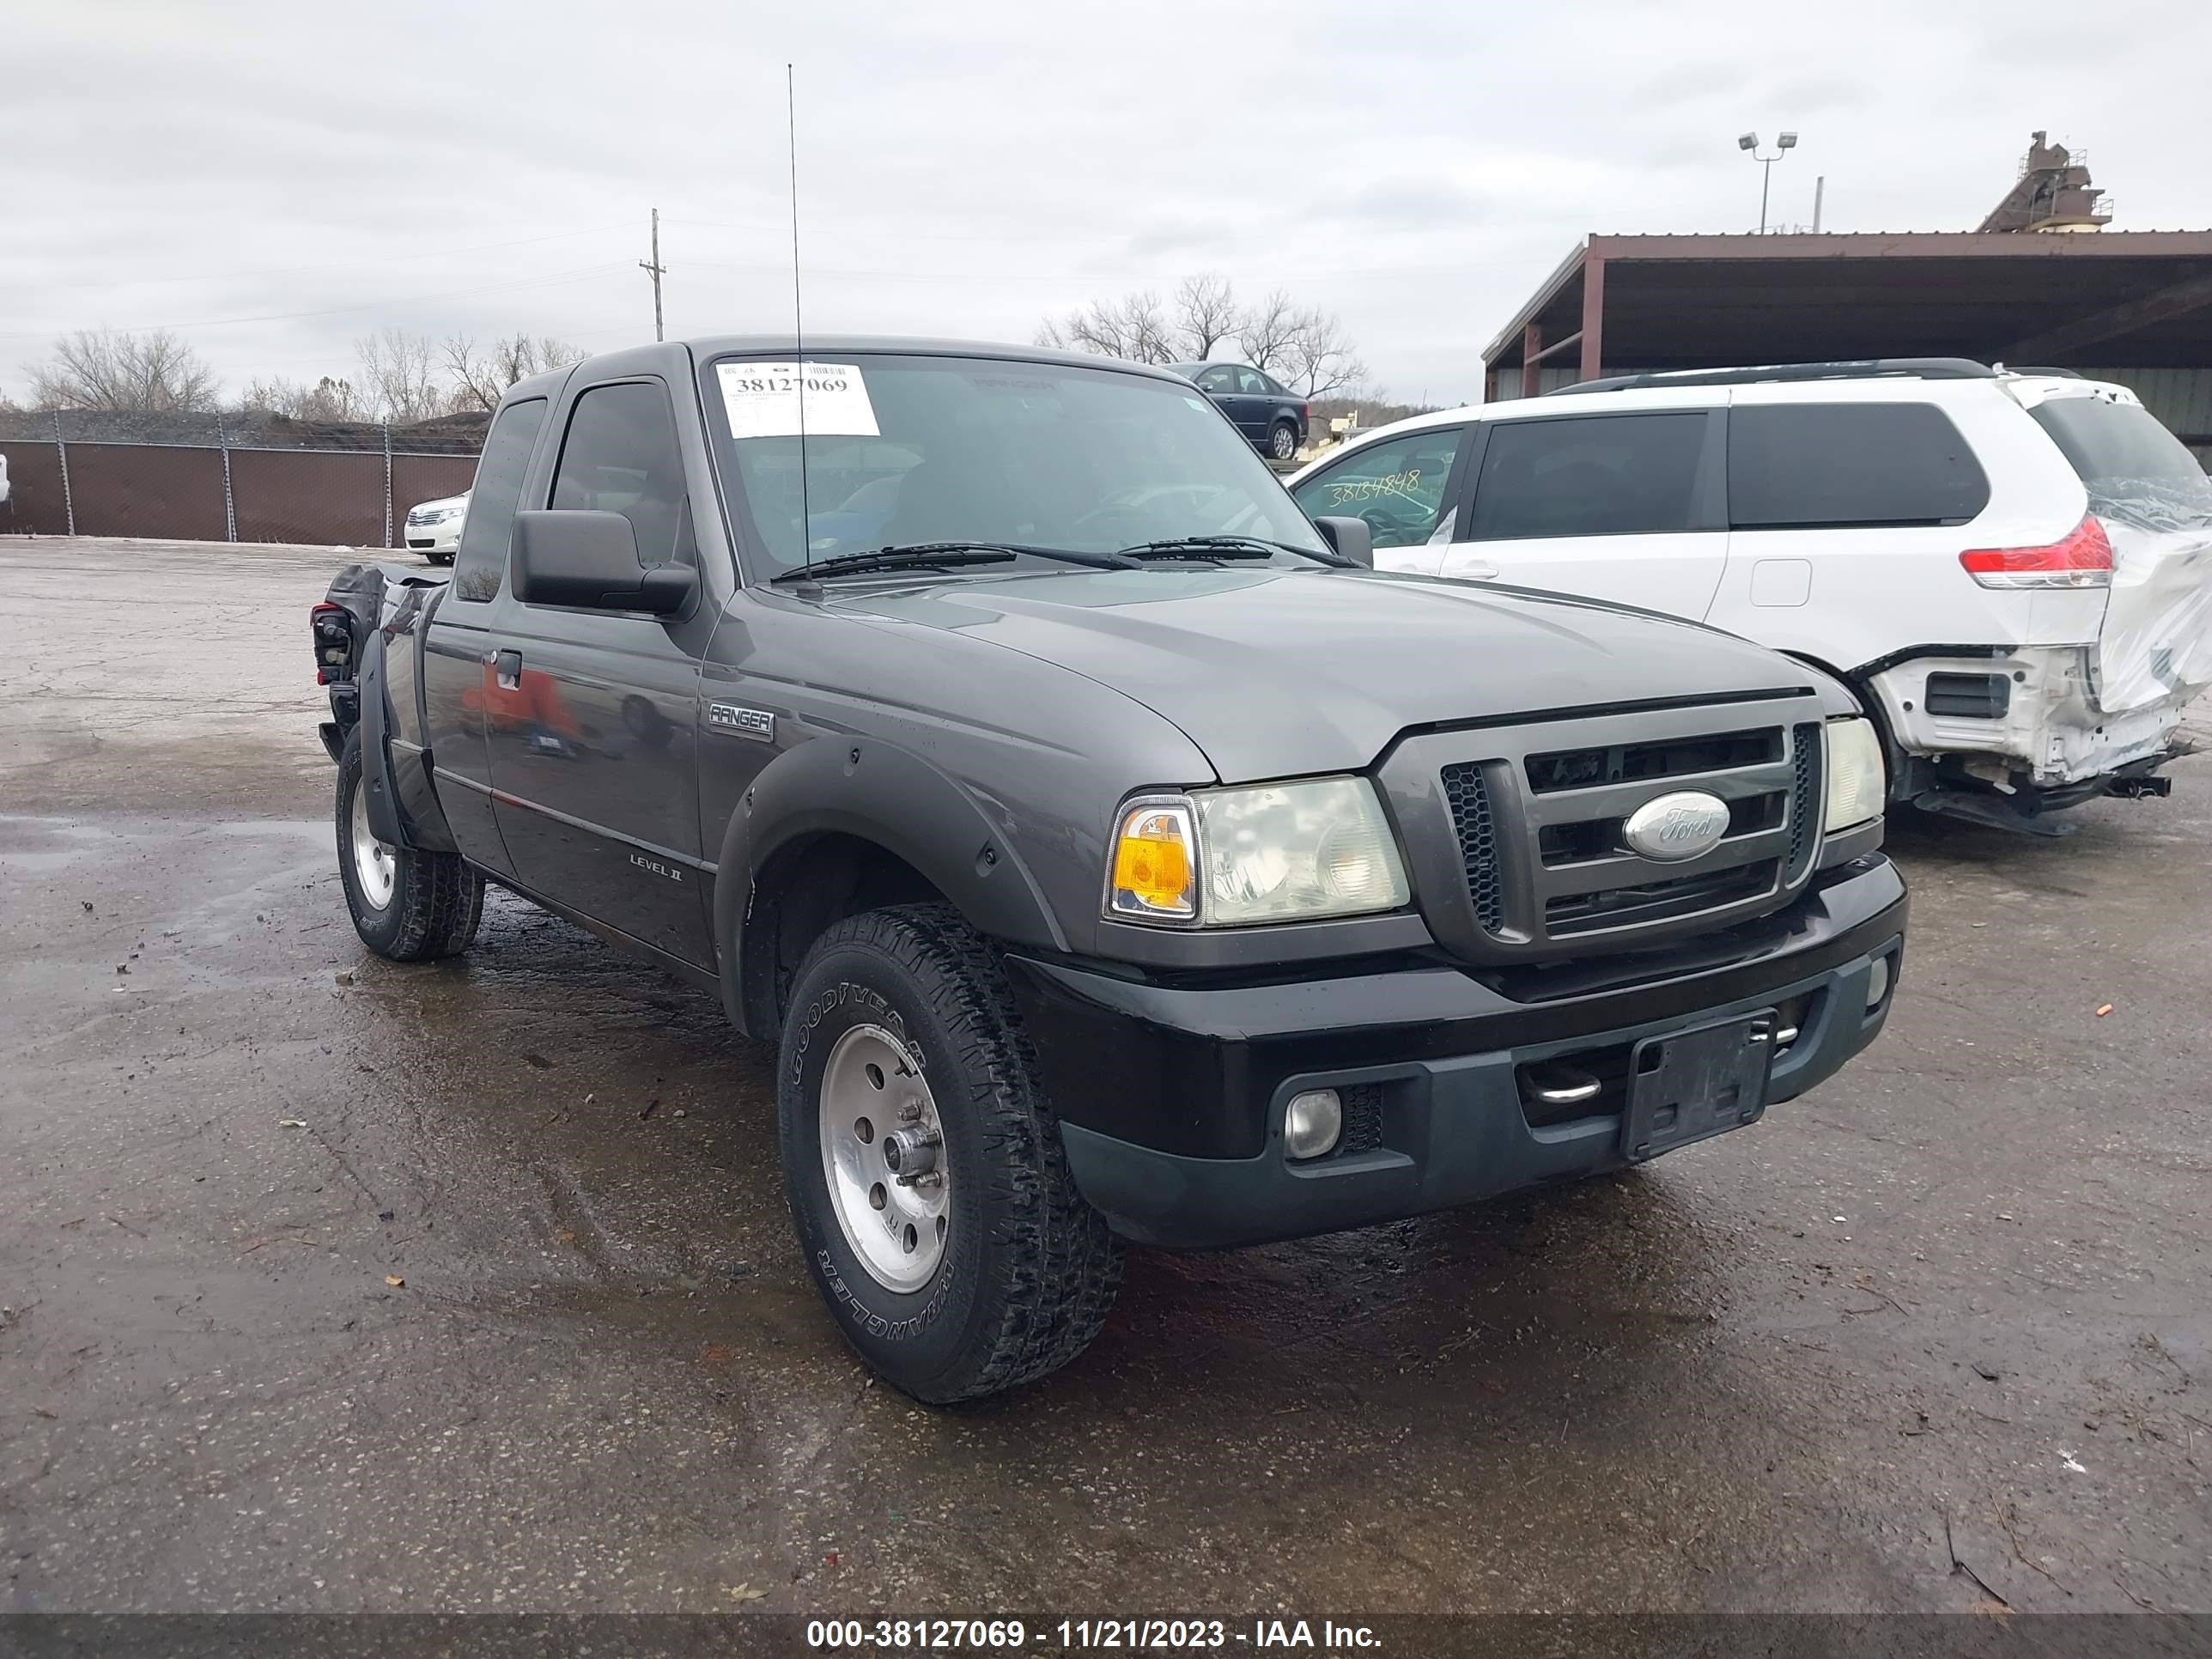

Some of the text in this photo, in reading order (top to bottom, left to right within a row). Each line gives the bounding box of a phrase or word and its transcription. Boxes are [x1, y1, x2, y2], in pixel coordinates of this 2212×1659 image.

[736, 378, 848, 392] 38127069
[710, 706, 771, 730] RANGER
[1658, 805, 1712, 843] Ford
[629, 854, 683, 882] LEVEL II
[790, 982, 927, 1085] GOODYEAR
[817, 1249, 955, 1340] WRANGLER
